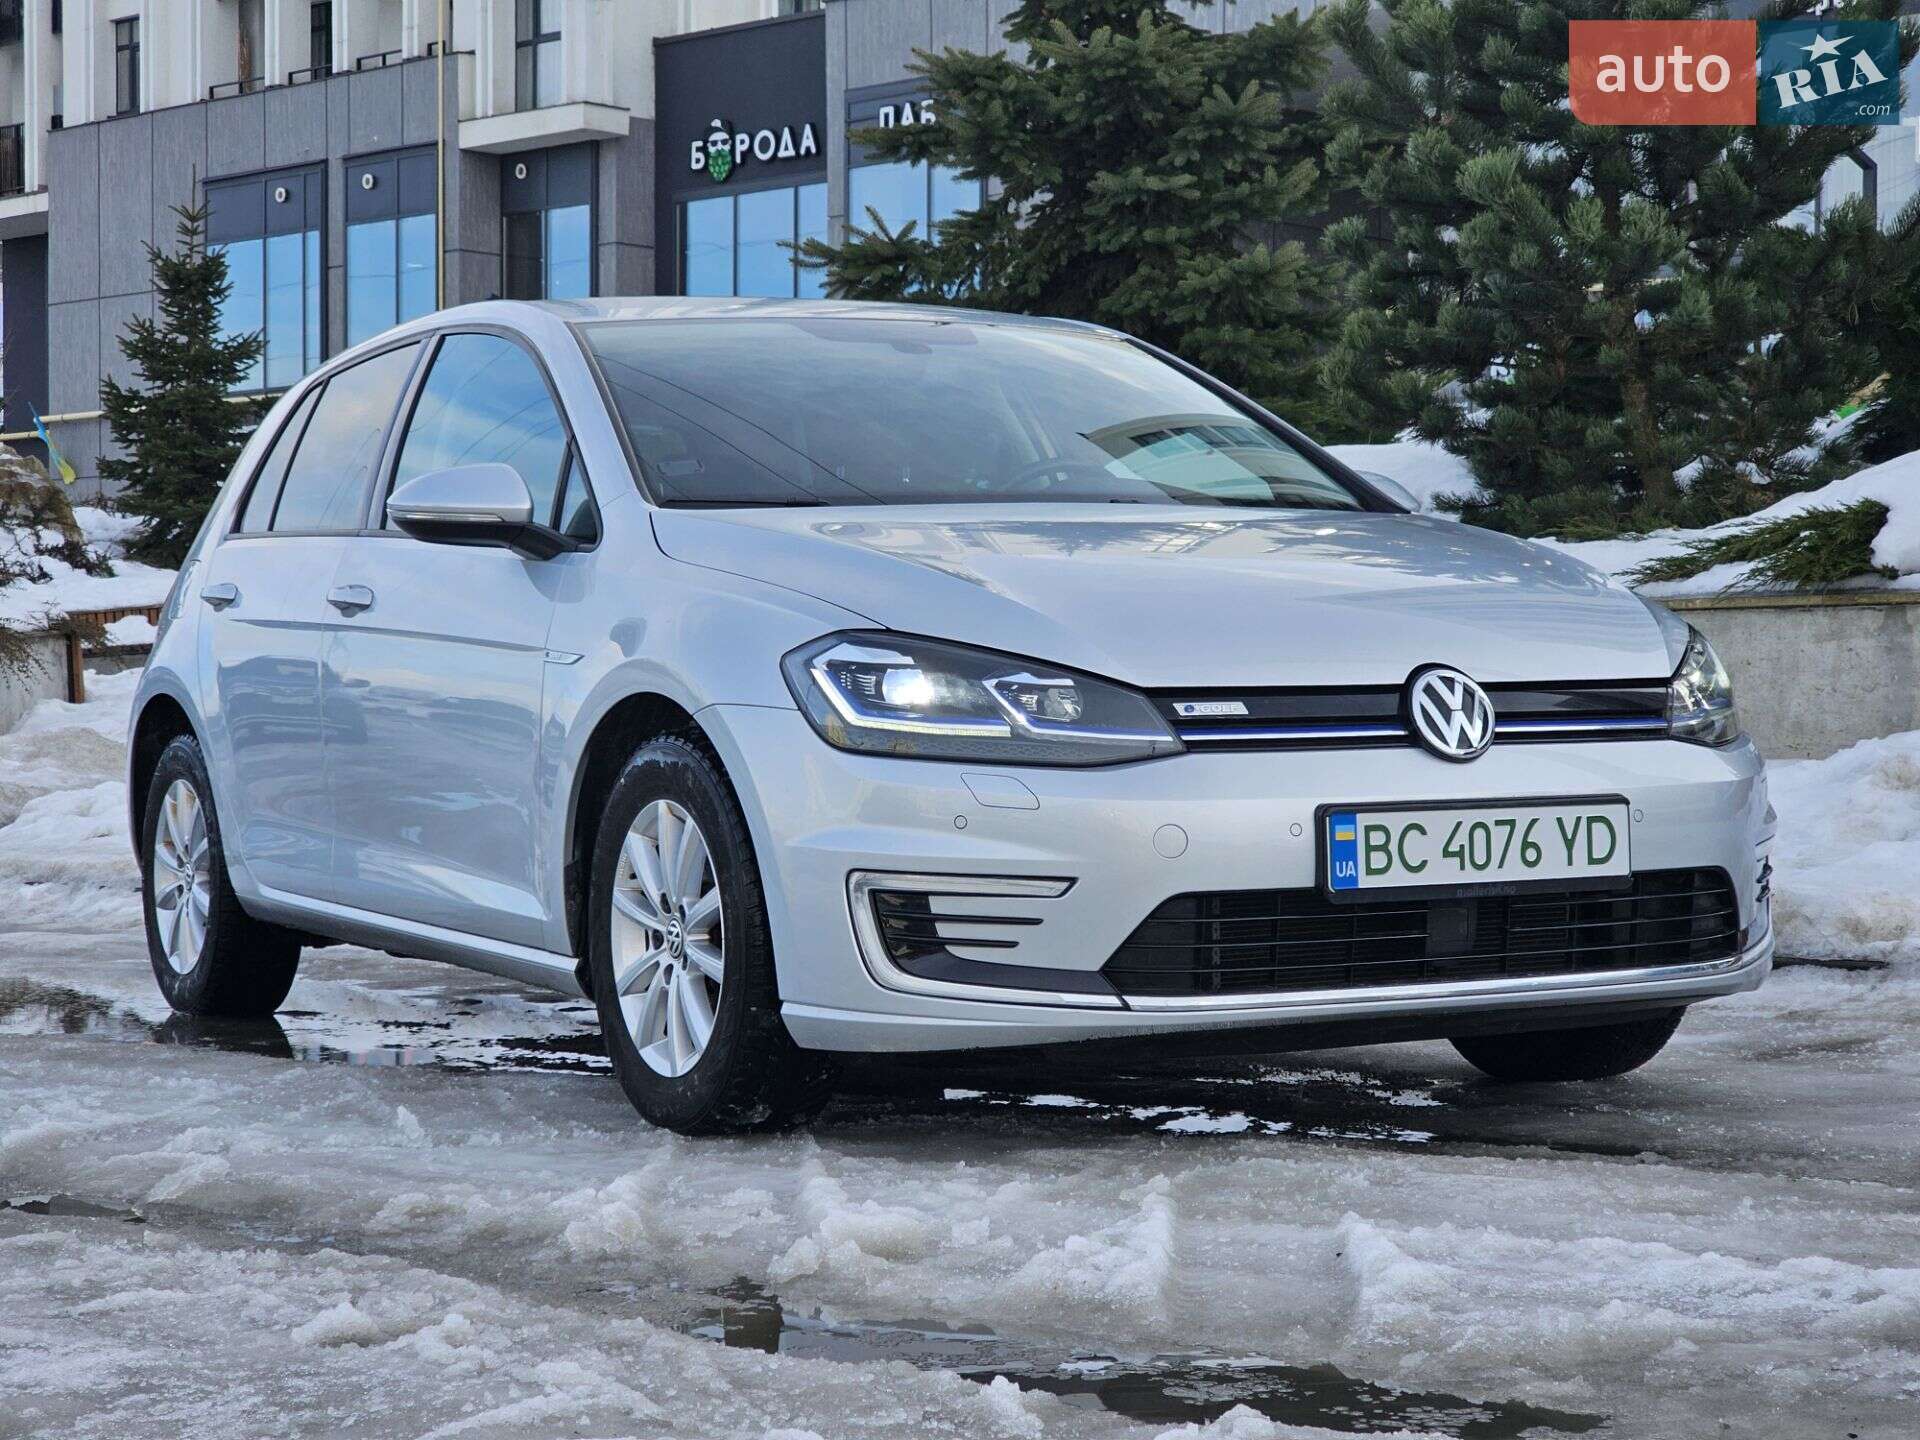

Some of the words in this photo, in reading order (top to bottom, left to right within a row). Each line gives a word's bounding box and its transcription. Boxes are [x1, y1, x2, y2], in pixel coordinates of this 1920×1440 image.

[690, 123, 817, 170] БРОДА
[1336, 860, 1356, 878] UA
[1363, 822, 1428, 877] BC
[1442, 817, 1543, 872] 4076
[1555, 815, 1617, 867] YD
